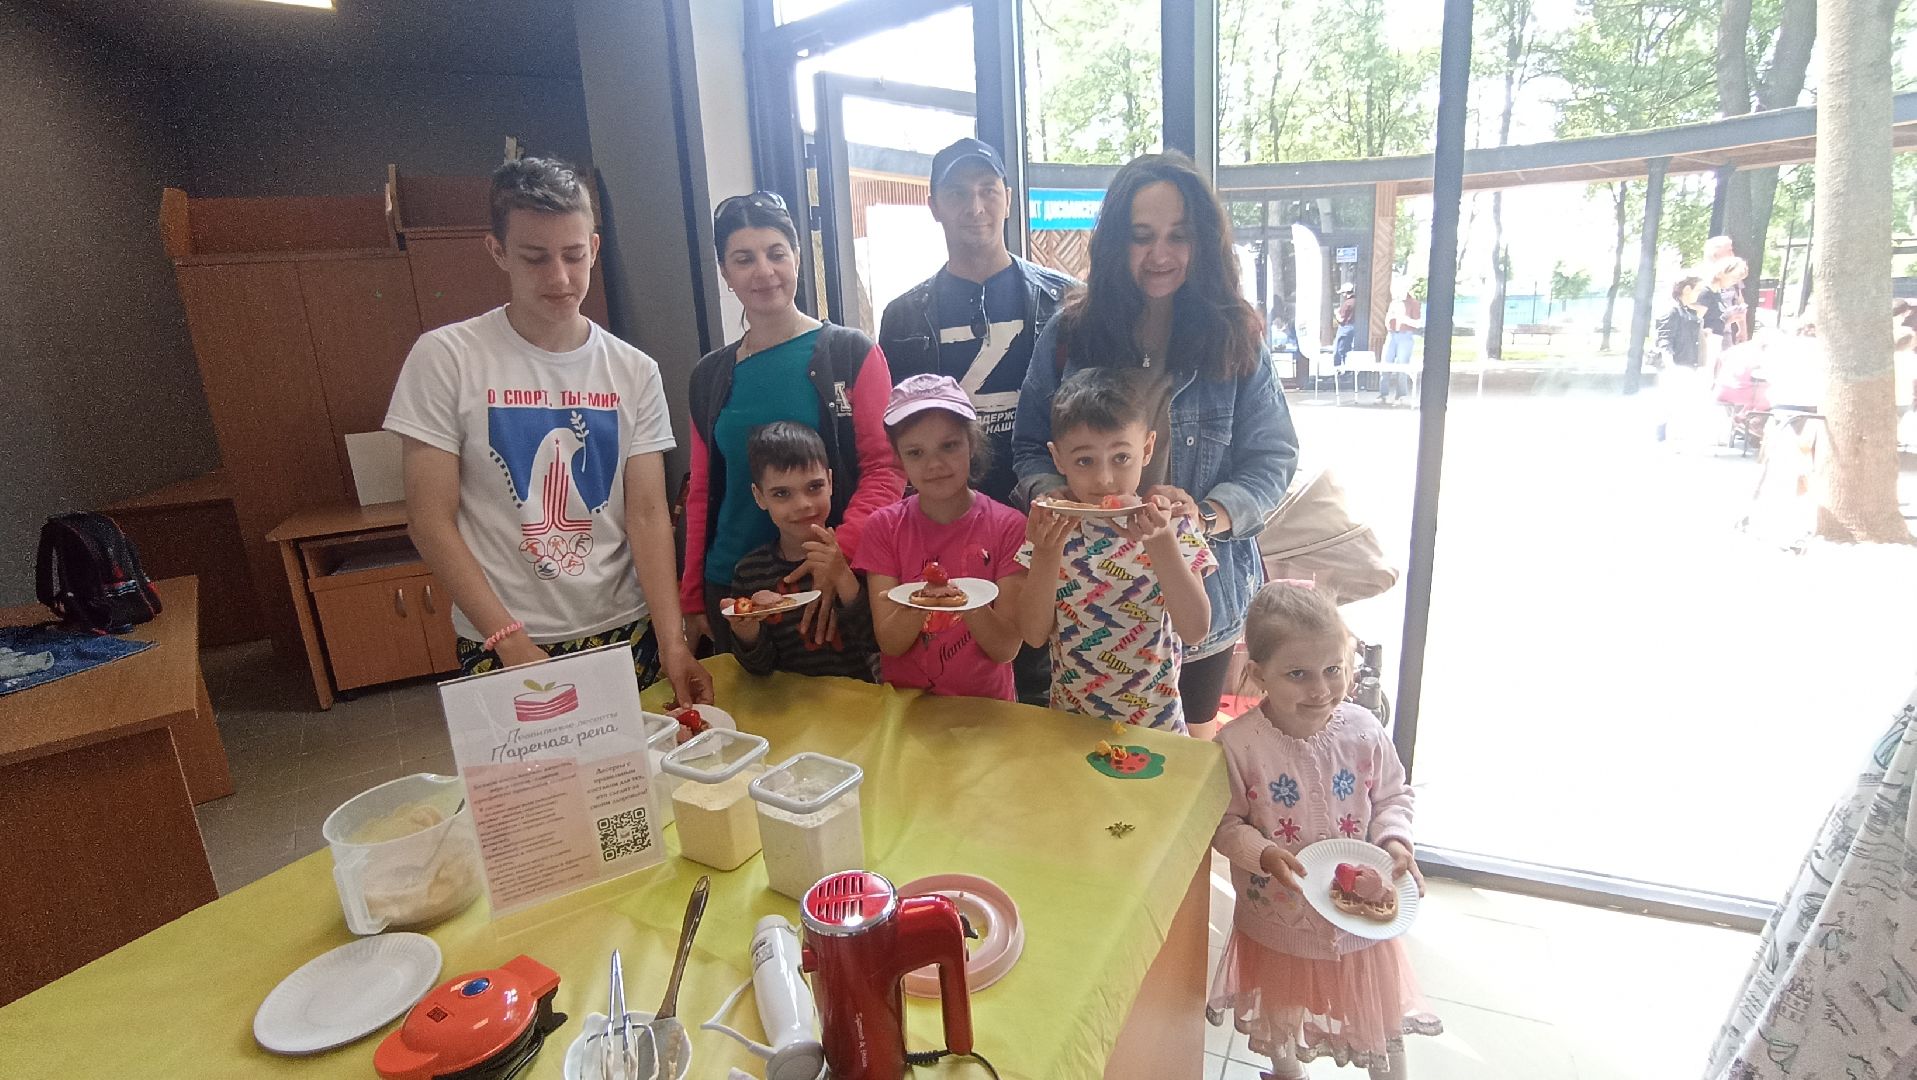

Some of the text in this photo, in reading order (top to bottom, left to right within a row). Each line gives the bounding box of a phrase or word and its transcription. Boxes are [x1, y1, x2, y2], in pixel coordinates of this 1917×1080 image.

[488, 388, 496, 405] О
[504, 388, 553, 408] СПОРТ,
[491, 723, 619, 762] Пареная репа
